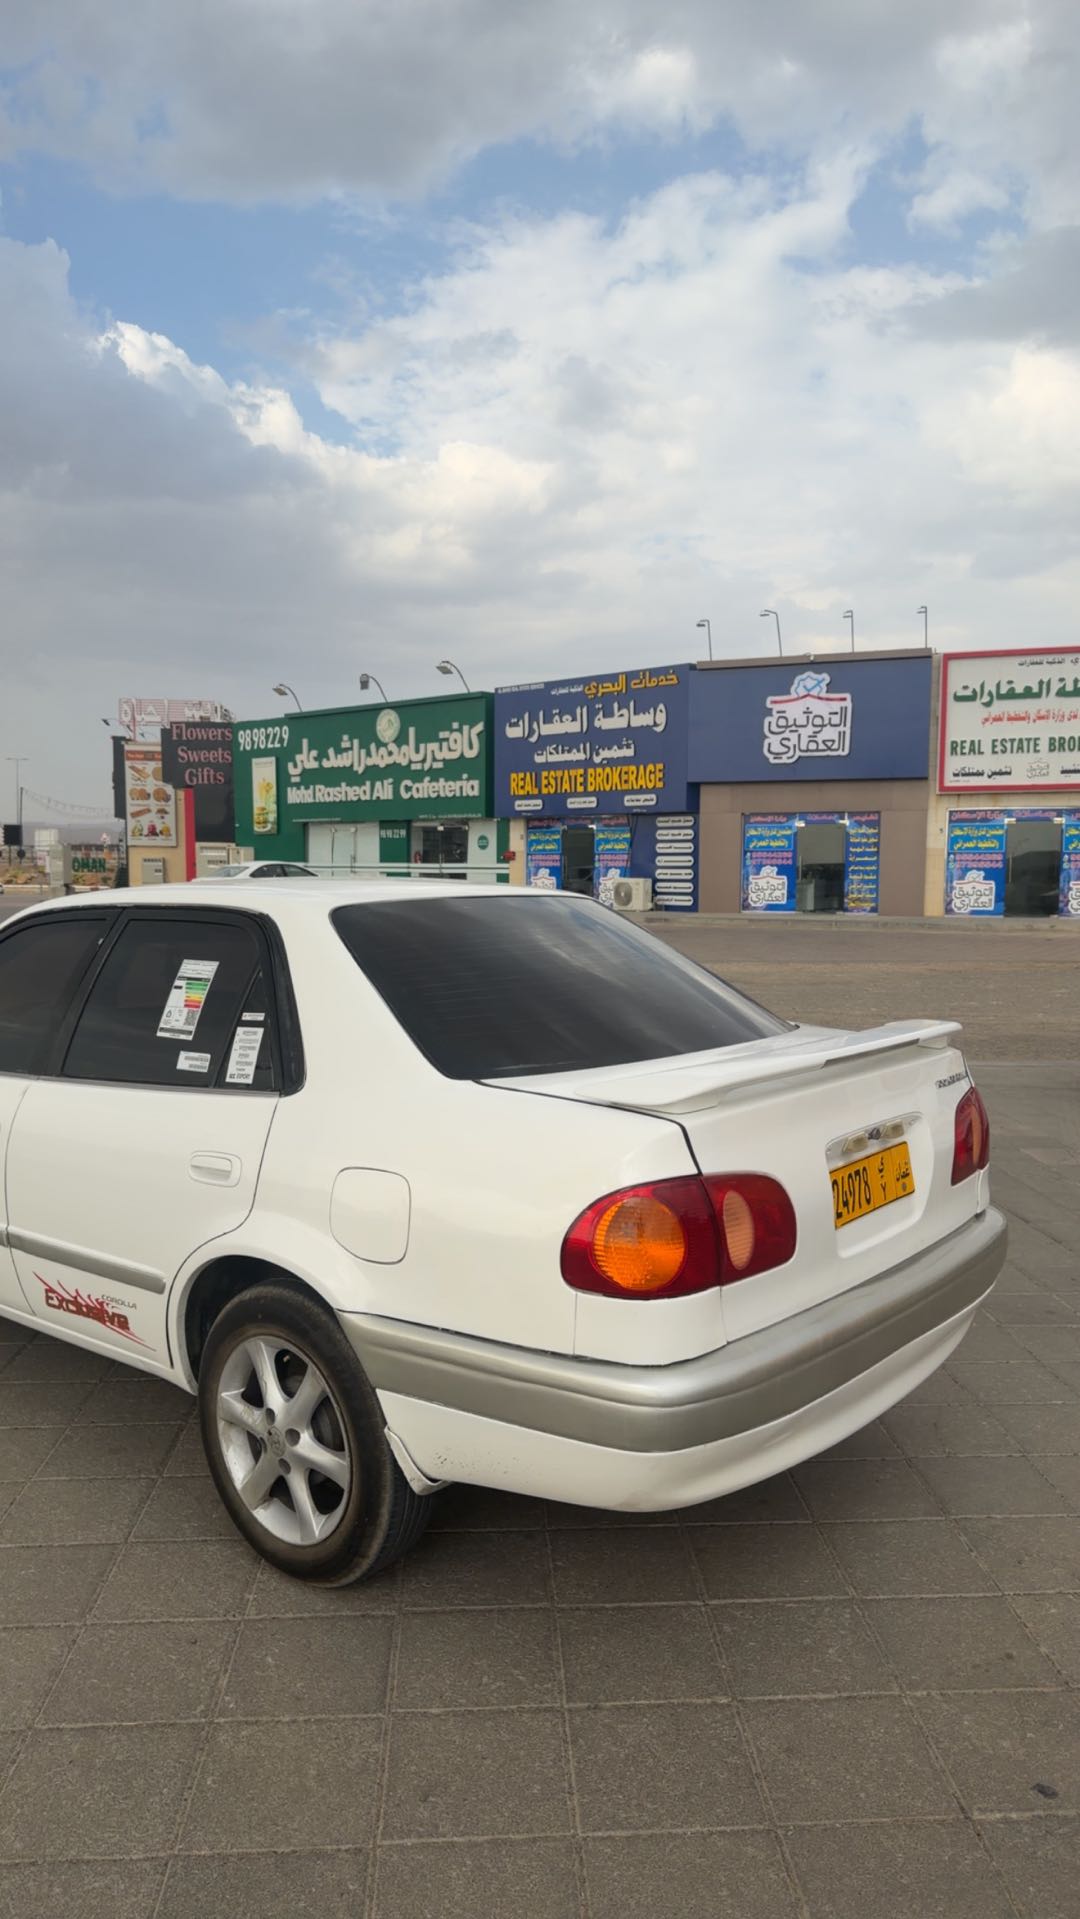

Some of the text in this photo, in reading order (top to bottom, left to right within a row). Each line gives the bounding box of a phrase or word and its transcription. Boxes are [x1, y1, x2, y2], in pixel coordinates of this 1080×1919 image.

[584, 669, 679, 698] خدمات البحري
[953, 677, 1052, 707] العقارات
[171, 723, 233, 741] Flowers
[505, 700, 667, 743] وساطة العقارات
[768, 706, 848, 735] التوثيق
[238, 725, 289, 751] 9898229
[287, 721, 484, 783] كافتيريا محمد راشد علي
[534, 737, 635, 764] تثمين الممتلكات
[768, 730, 846, 759] العقاري
[950, 739, 984, 756] REAL
[992, 737, 1041, 755] ESTATE
[177, 746, 232, 763] Sweets
[184, 766, 225, 785] Gifts
[287, 773, 480, 804] Mohd Rashed Ali Cafeteria
[510, 763, 665, 796] REAL ESTATE BROKERAGE
[72, 857, 106, 873] OMAN
[831, 1166, 872, 1219] 24978
[880, 1181, 887, 1200] Y
[101, 1293, 138, 1310] COROLLA
